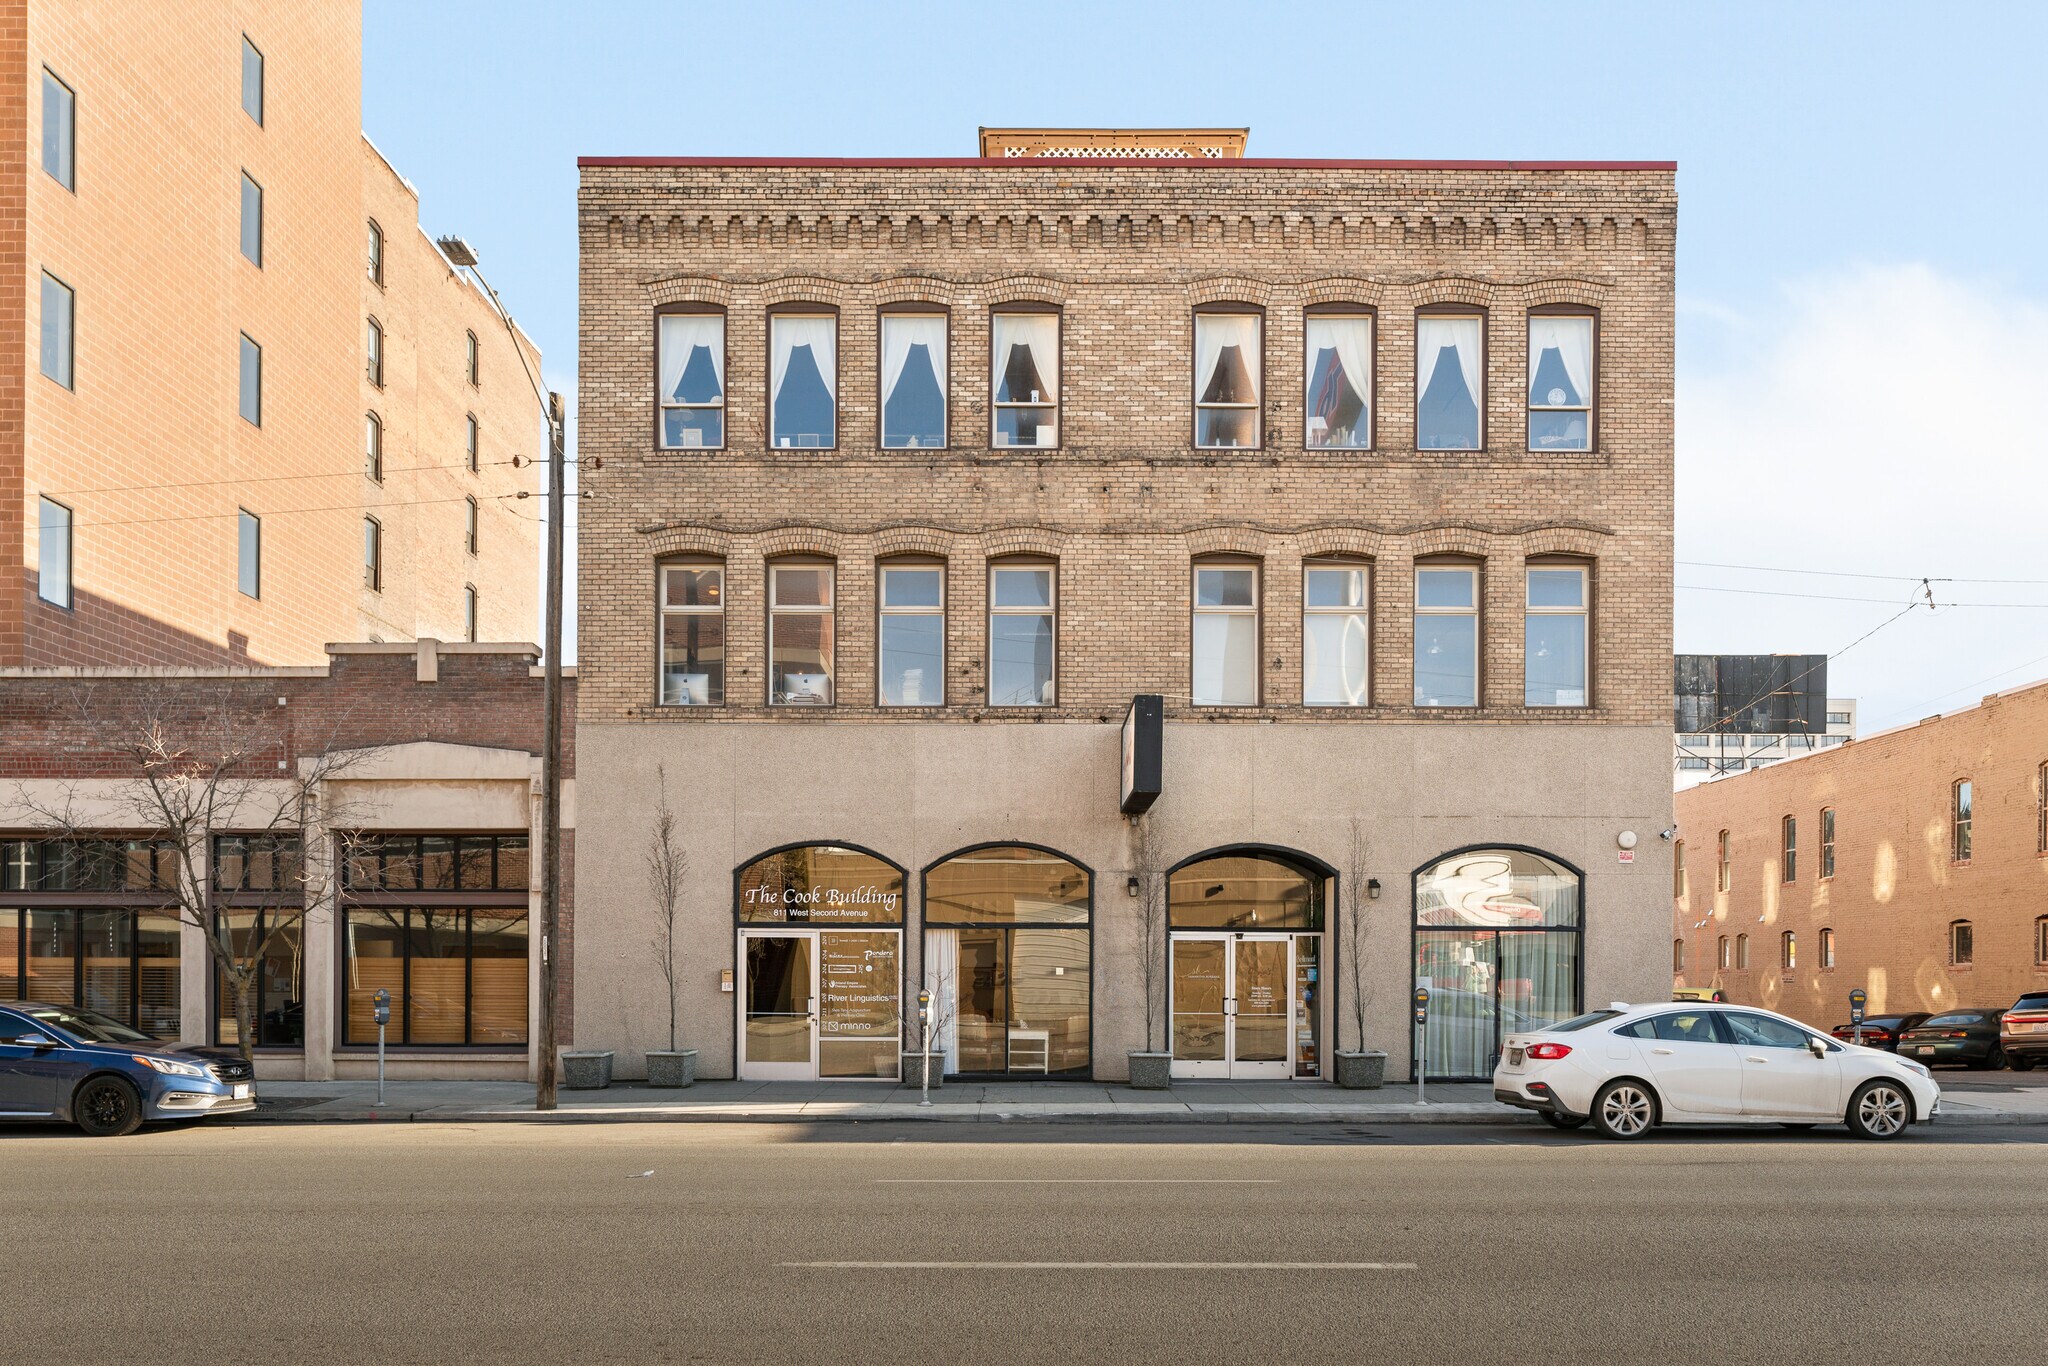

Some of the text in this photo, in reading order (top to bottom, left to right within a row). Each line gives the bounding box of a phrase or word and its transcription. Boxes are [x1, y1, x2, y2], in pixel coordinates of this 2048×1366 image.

[745, 884, 897, 912] The Cook Building
[773, 909, 868, 917] 811 West Second Avenue
[828, 994, 848, 1002] River
[849, 994, 890, 1004] Linguistics
[840, 1022, 871, 1030] minno
